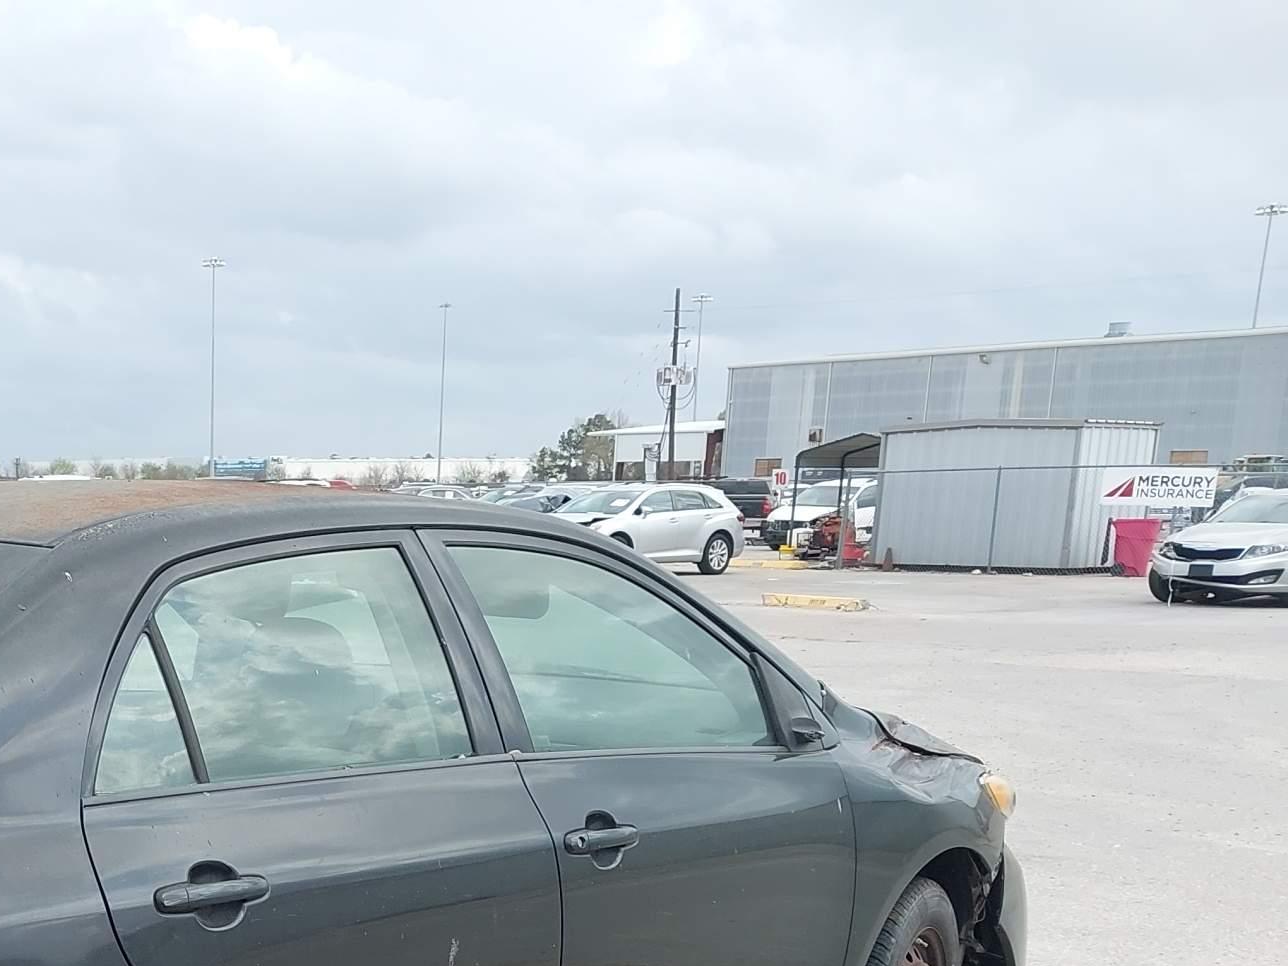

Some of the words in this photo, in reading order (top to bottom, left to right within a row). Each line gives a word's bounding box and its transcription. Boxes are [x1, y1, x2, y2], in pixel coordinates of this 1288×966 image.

[775, 471, 787, 486] 10
[1137, 475, 1215, 488] MERCURY
[1136, 487, 1214, 500] INSURANCE
